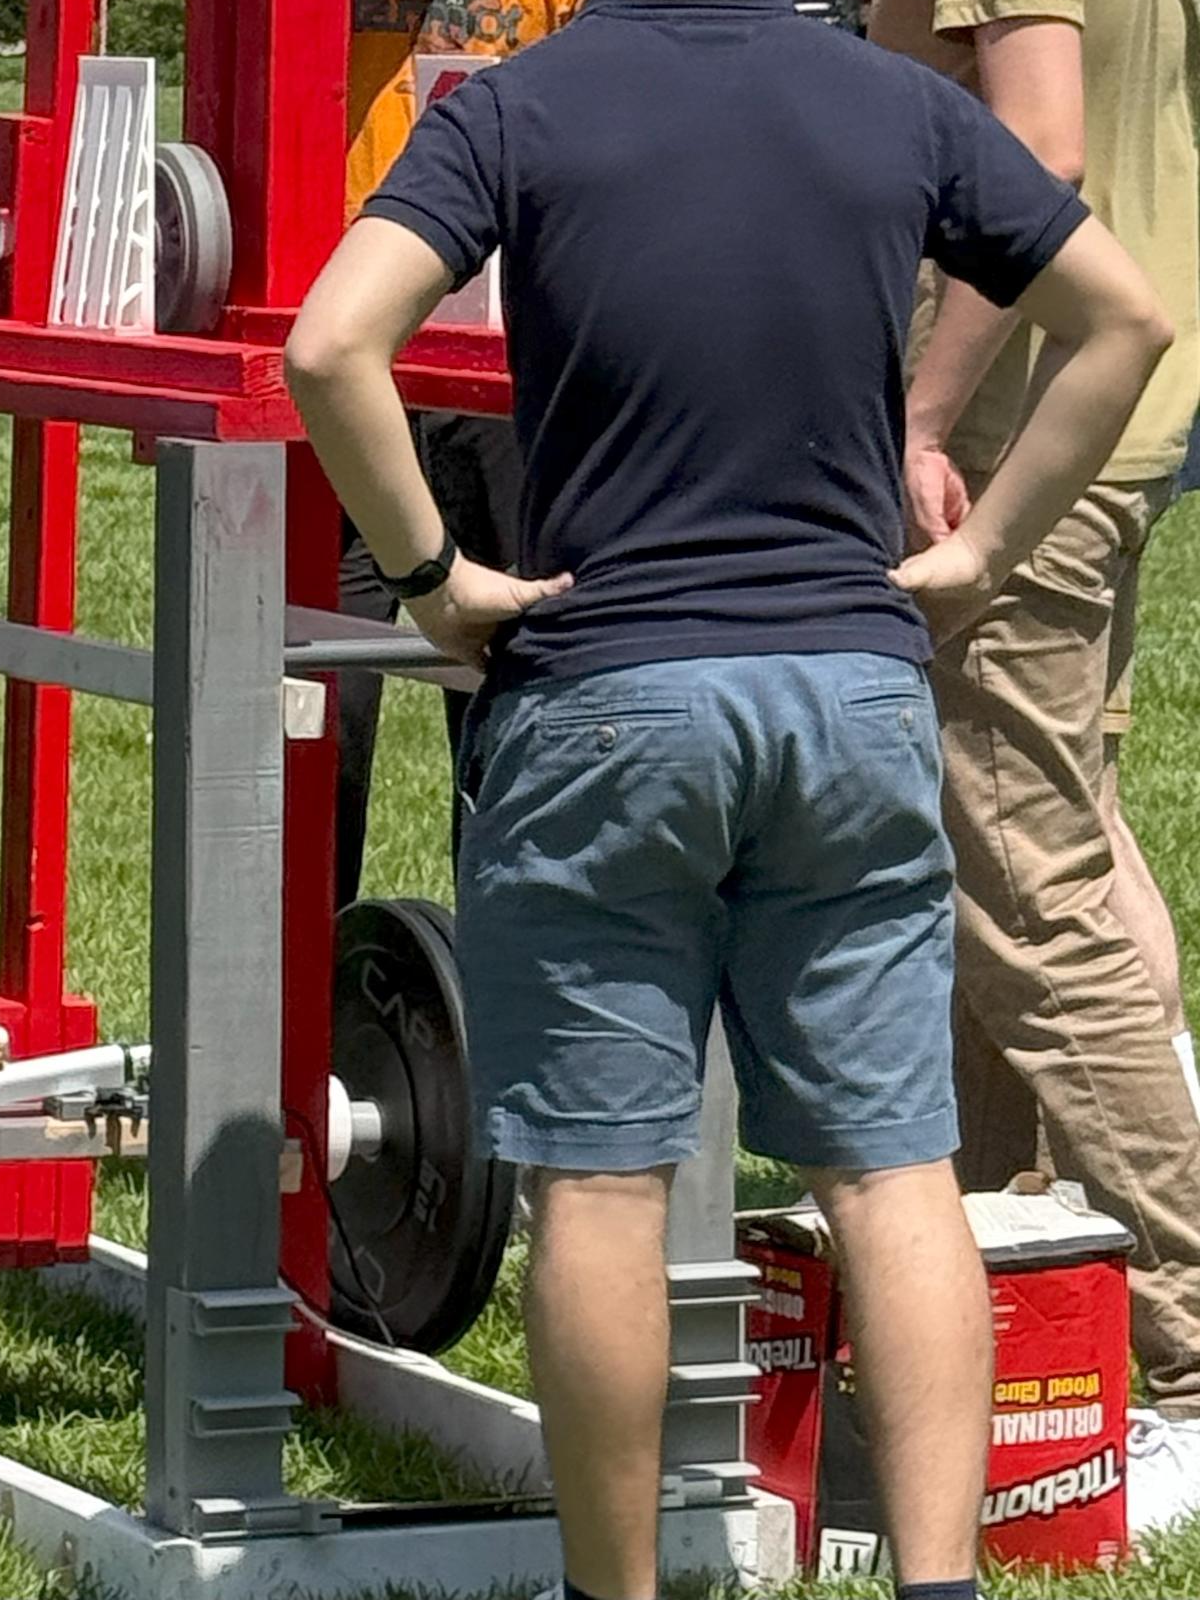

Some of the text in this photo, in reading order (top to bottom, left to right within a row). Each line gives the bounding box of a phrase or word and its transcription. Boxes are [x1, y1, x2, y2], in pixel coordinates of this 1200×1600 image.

[745, 1336, 817, 1374] Titebo
[994, 1372, 1101, 1405] Wood Glue
[991, 1402, 1104, 1446] ORIGINAL
[979, 1447, 1122, 1526] Titebon
